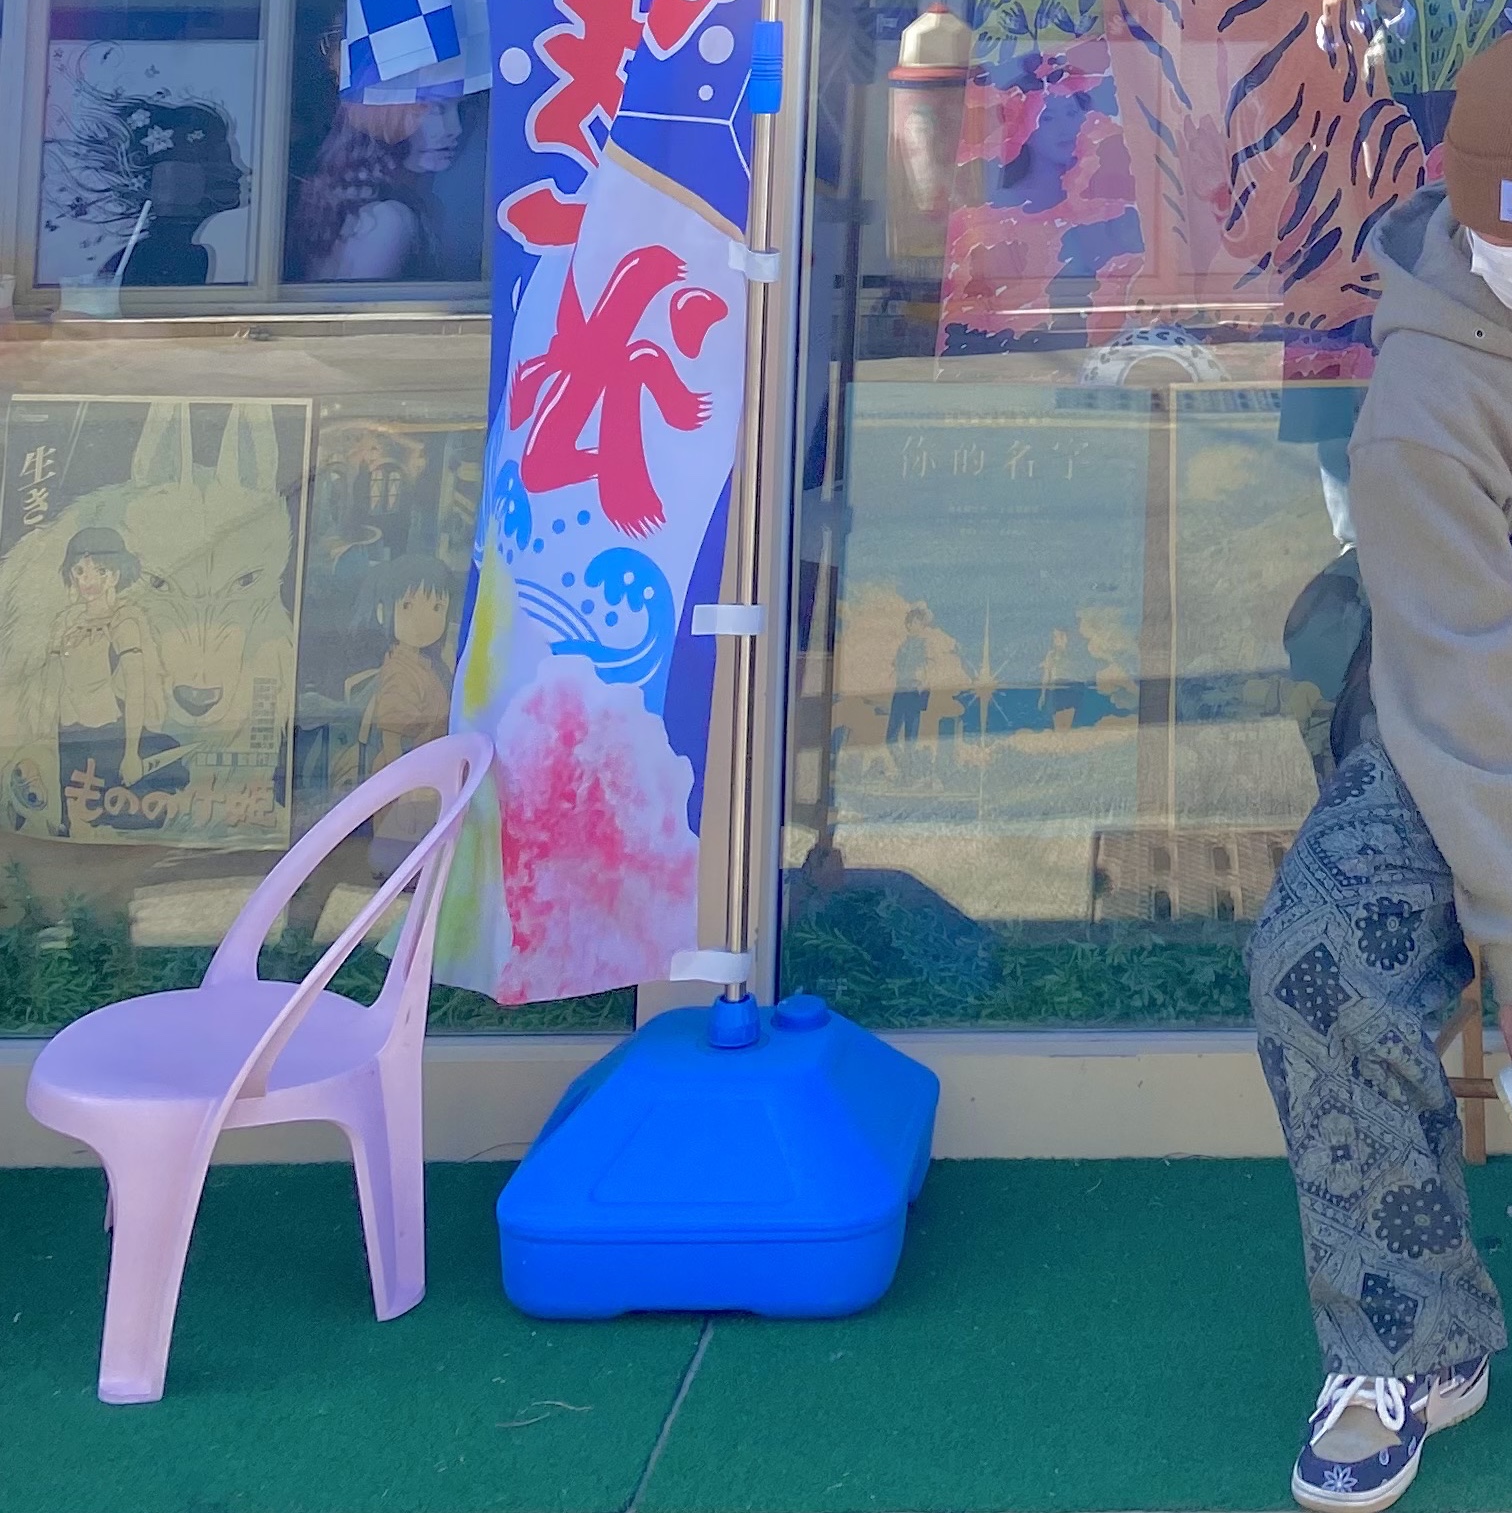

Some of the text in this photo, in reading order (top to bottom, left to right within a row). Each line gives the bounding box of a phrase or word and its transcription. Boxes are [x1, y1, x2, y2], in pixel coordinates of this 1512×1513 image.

[65, 757, 278, 829] もののけ姫
